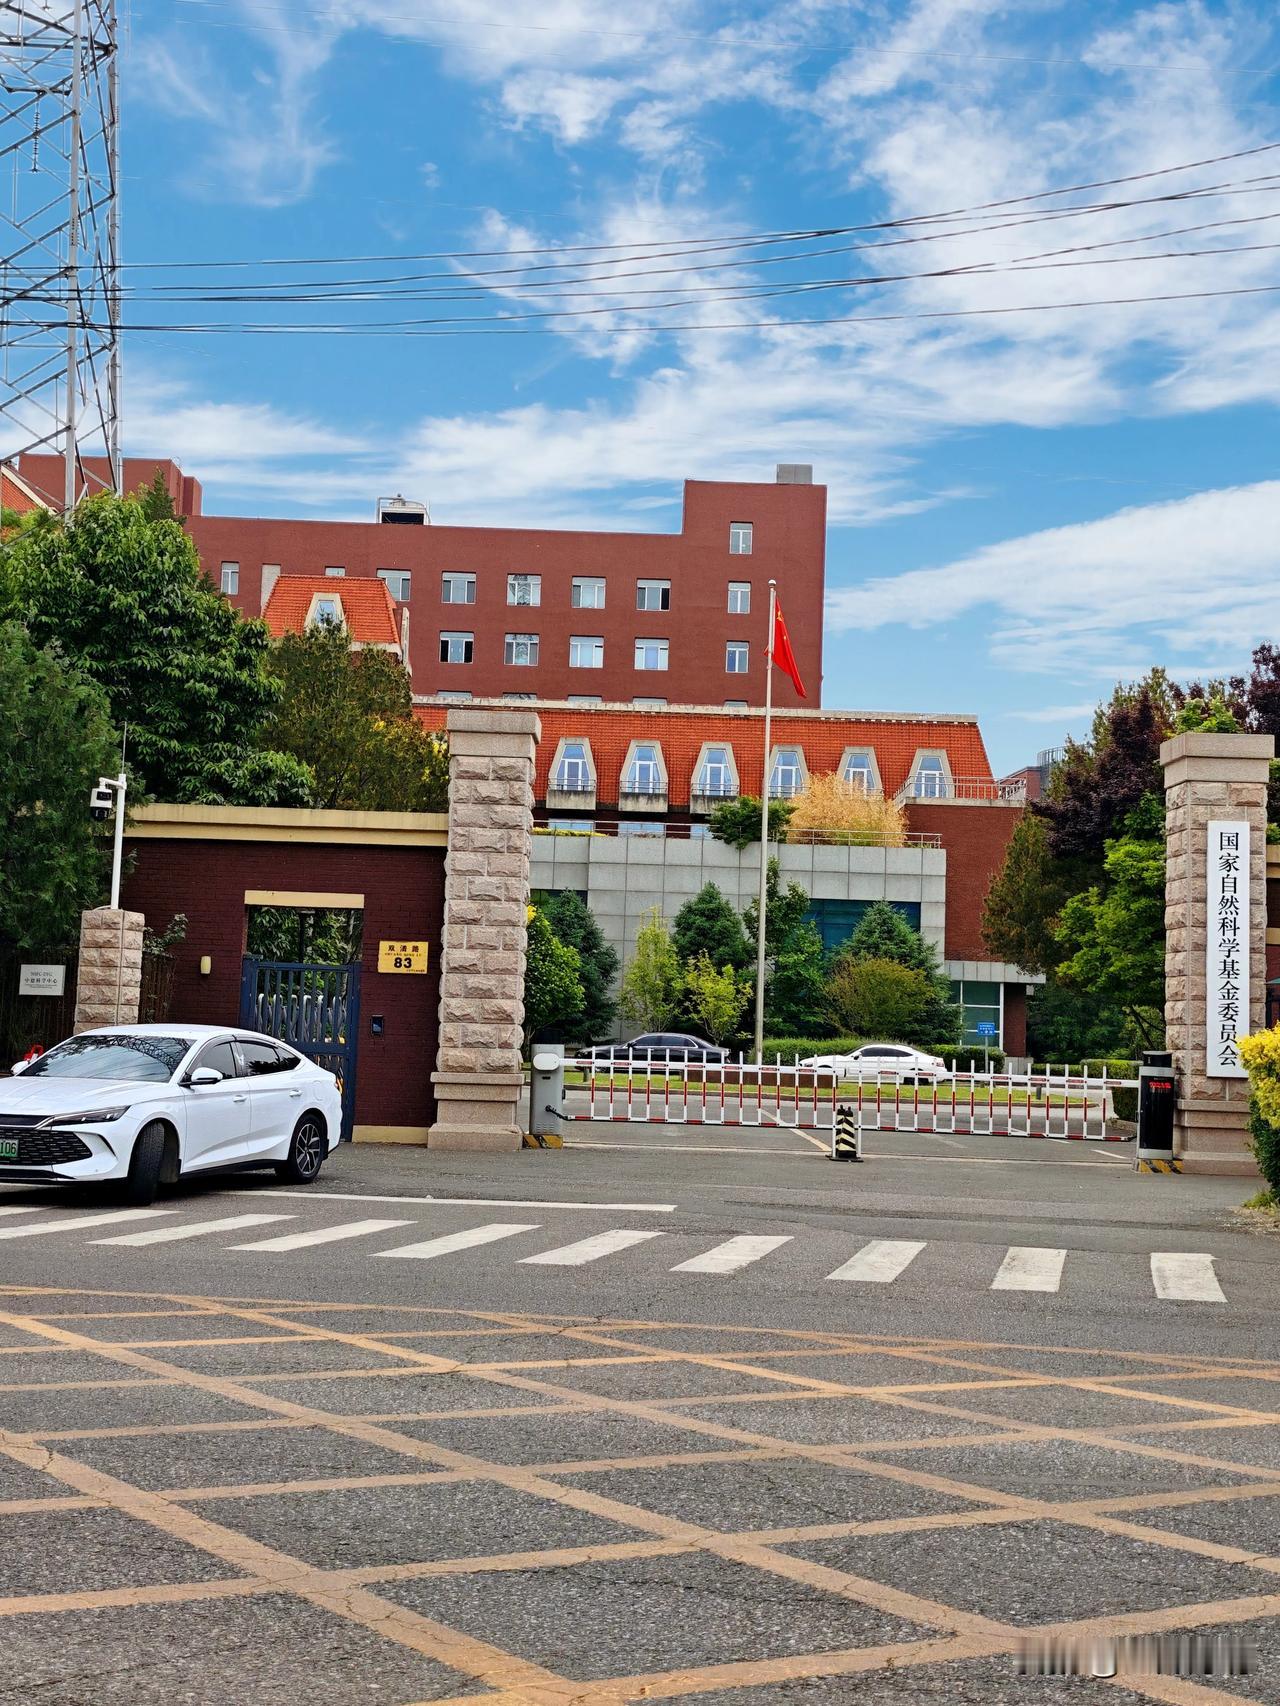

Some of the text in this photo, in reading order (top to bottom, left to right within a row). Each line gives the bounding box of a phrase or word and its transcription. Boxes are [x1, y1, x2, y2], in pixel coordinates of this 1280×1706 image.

[394, 957, 412, 969] 83
[1218, 831, 1240, 1067] 国家自然科学基金委员会
